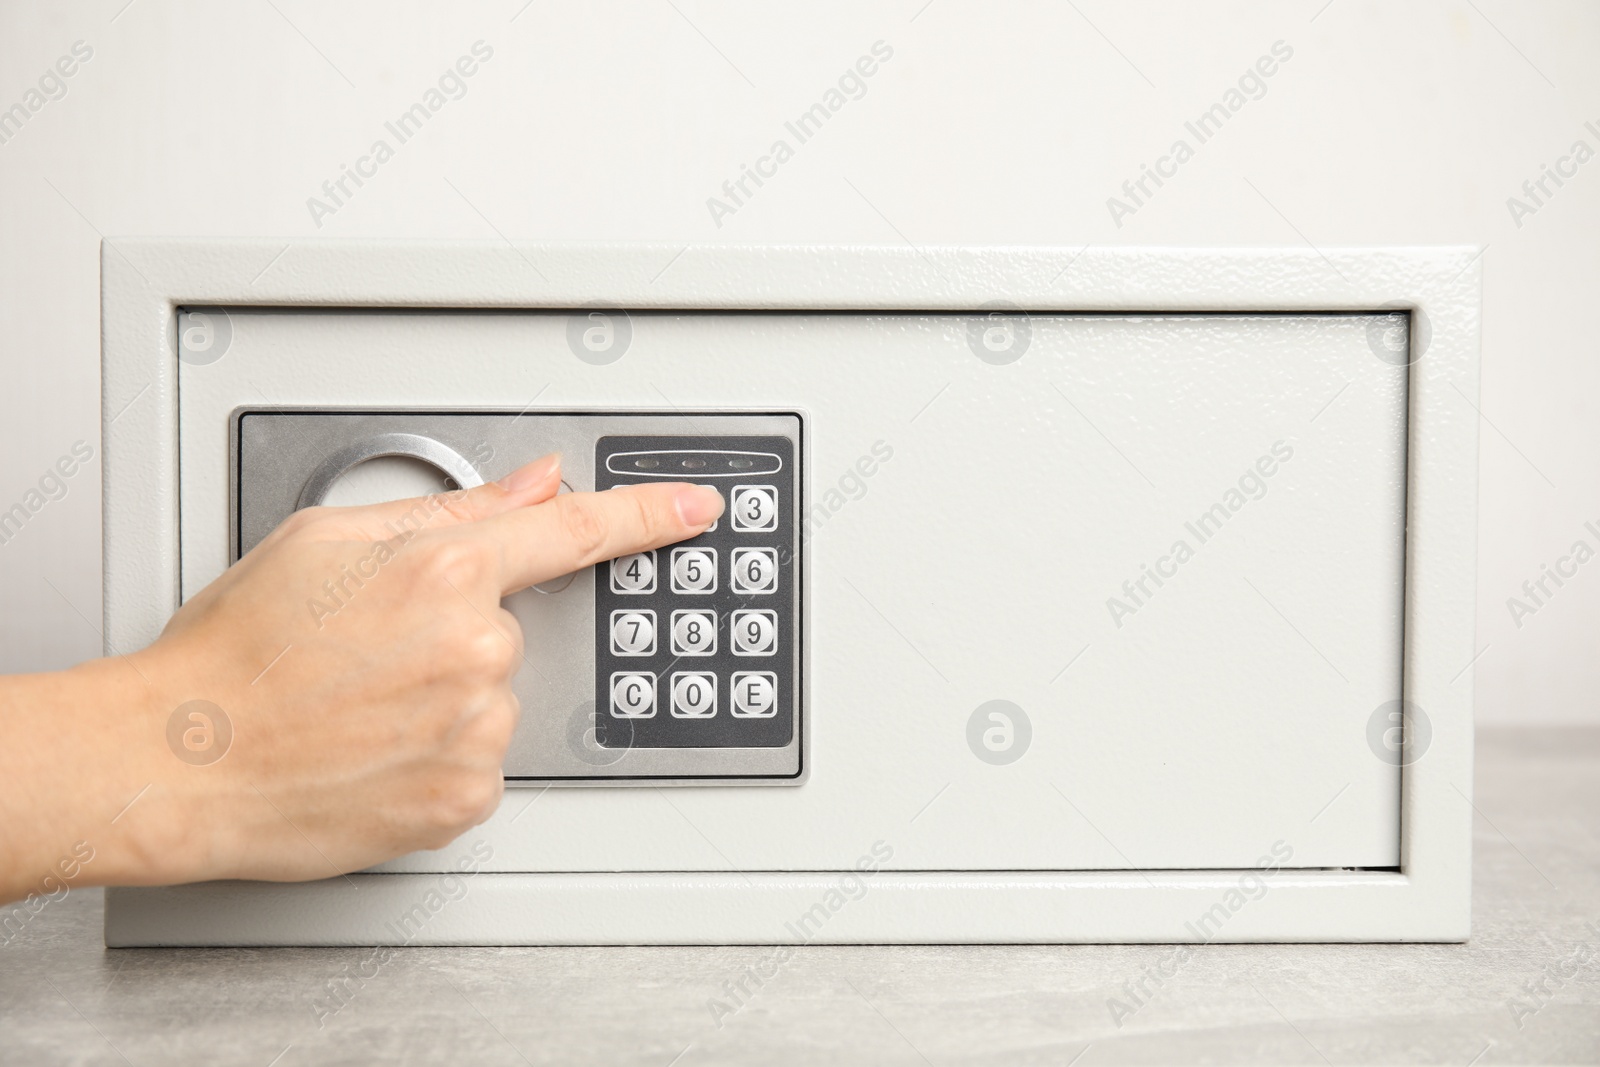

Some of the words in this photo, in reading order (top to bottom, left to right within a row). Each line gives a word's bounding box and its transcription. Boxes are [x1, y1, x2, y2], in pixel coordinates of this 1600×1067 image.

[747, 497, 762, 521] 3
[625, 559, 642, 583] 4
[686, 559, 701, 583] 5
[747, 559, 762, 583] 6
[627, 621, 641, 645] 7
[686, 621, 702, 645] 8
[747, 621, 762, 645] 9
[626, 683, 642, 707] C
[686, 683, 702, 707] 0
[747, 683, 762, 707] E
